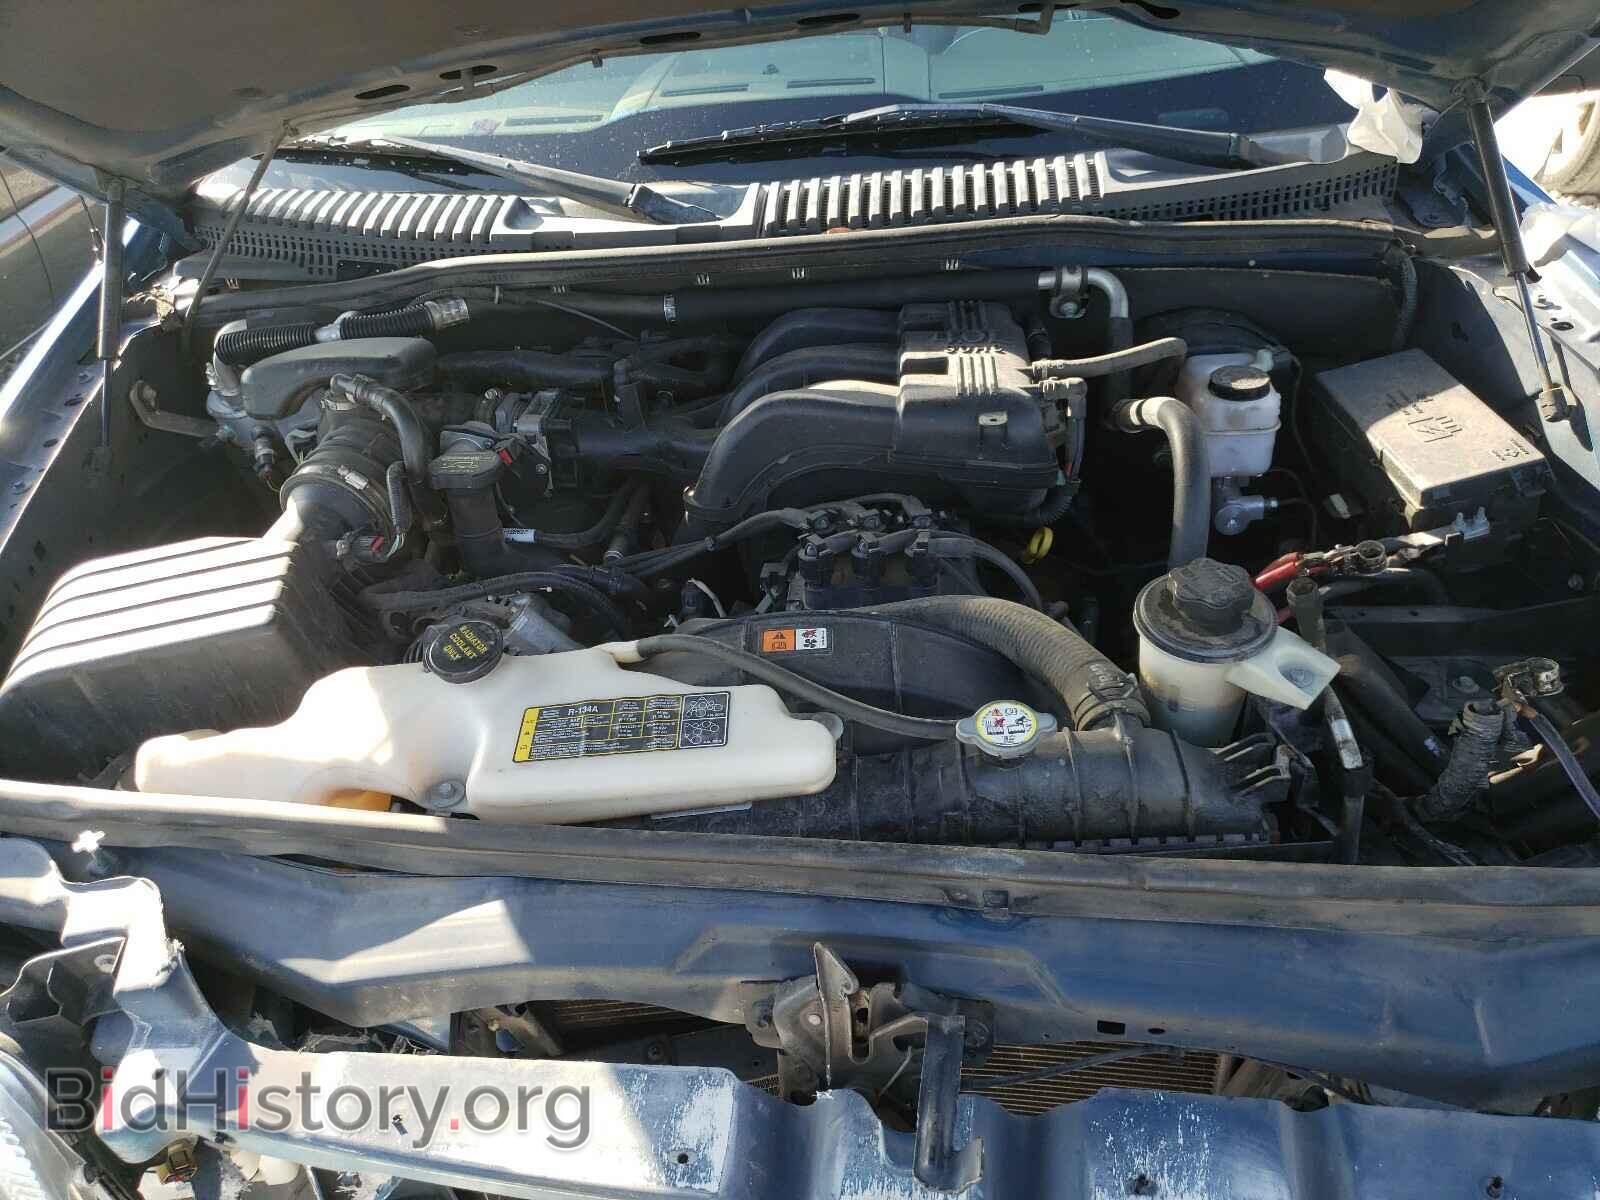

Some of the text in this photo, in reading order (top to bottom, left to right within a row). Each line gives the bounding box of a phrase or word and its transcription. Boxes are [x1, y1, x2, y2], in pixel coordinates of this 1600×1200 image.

[449, 633, 478, 660] COOLANT
[459, 625, 488, 654] RADIATOR
[443, 645, 462, 660] ONLY
[567, 705, 599, 716] R-134A
